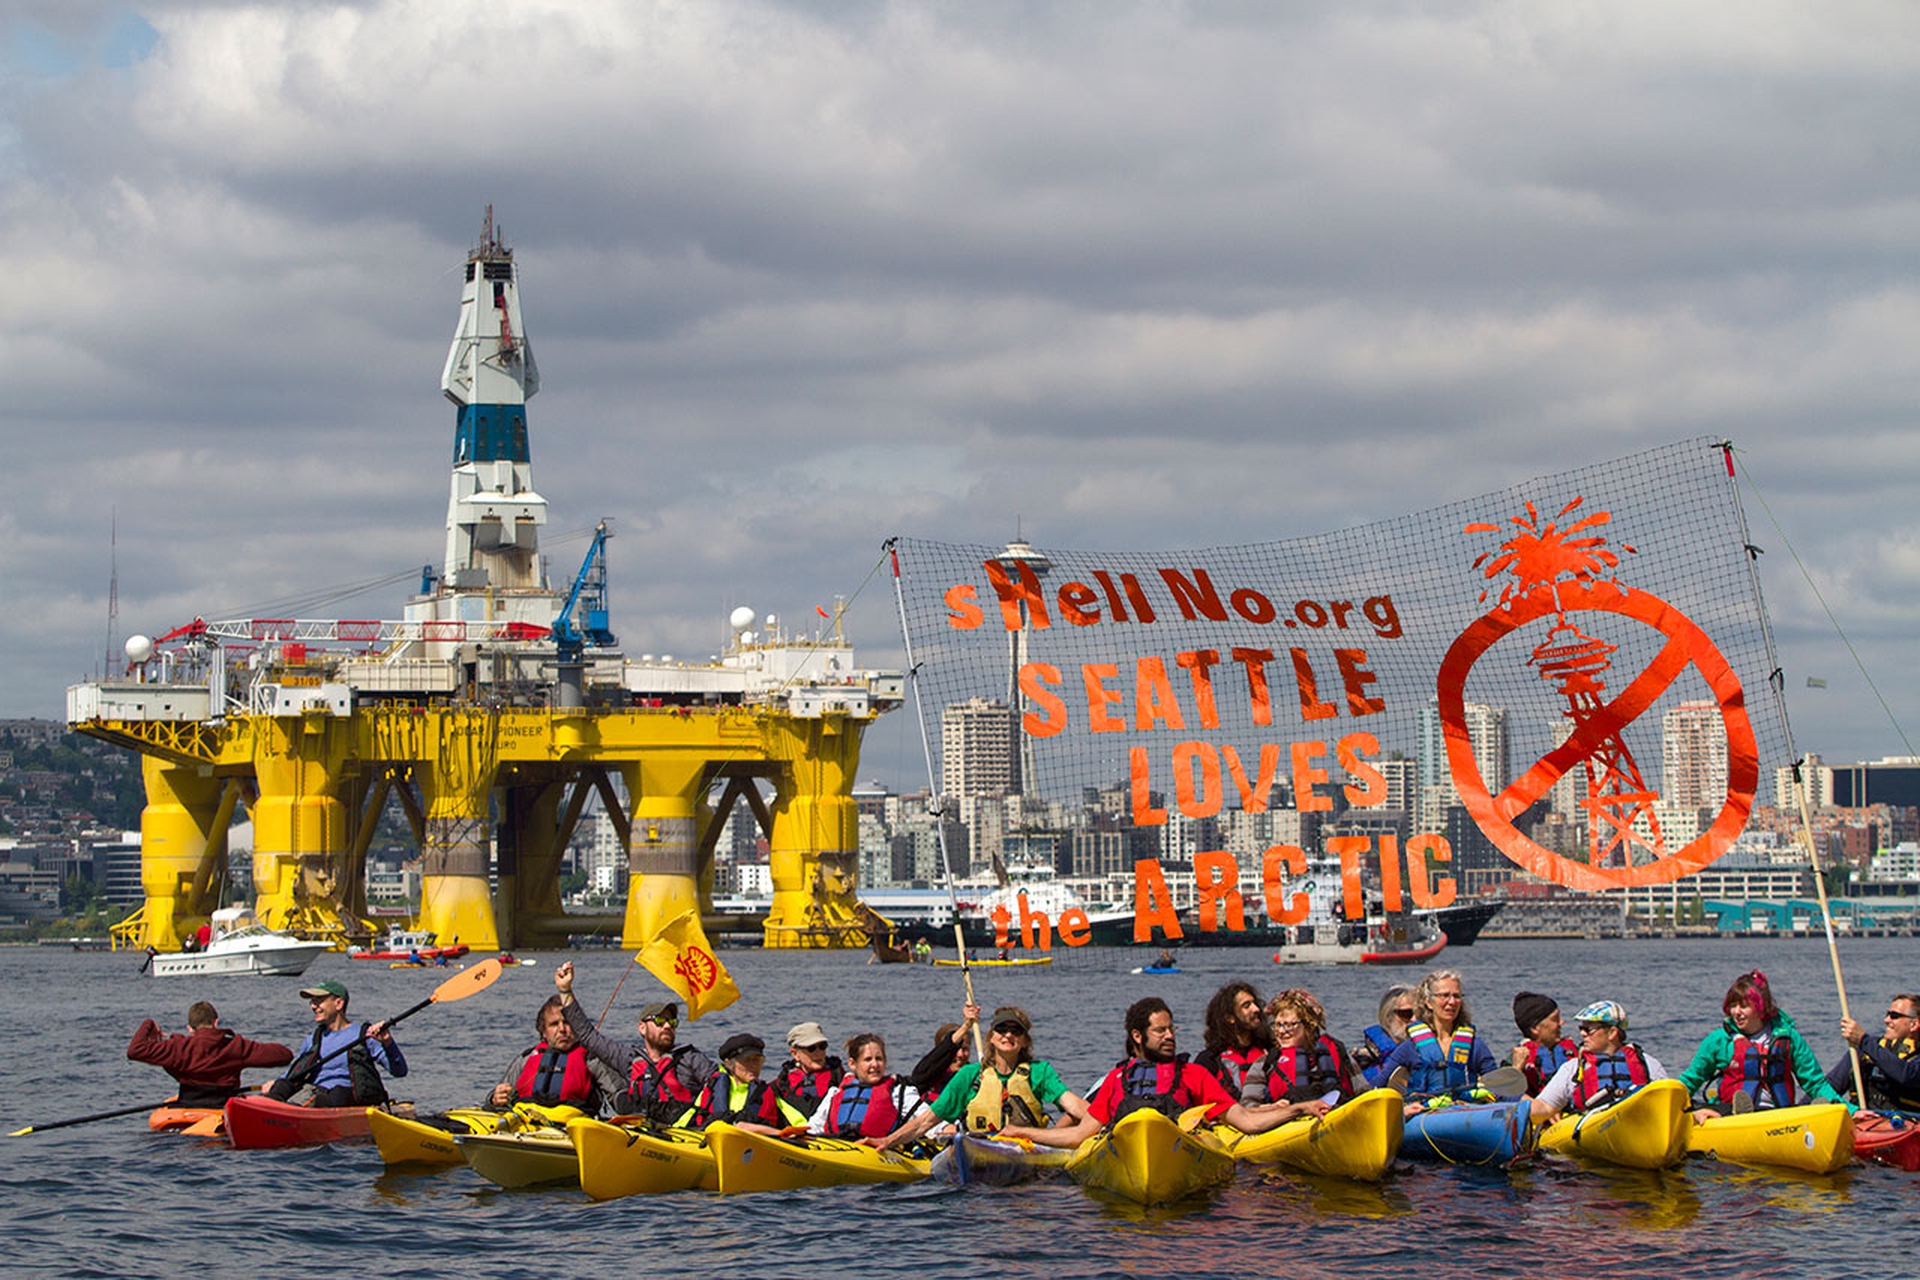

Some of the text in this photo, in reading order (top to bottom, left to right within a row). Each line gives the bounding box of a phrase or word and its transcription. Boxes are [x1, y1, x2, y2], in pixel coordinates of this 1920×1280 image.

[498, 725, 543, 737] PIONEER
[1018, 647, 1386, 738] SEATTLE
[1129, 731, 1389, 826] LOVES
[989, 832, 1458, 952] the ARCTIC
[1765, 1124, 1803, 1136] vector
